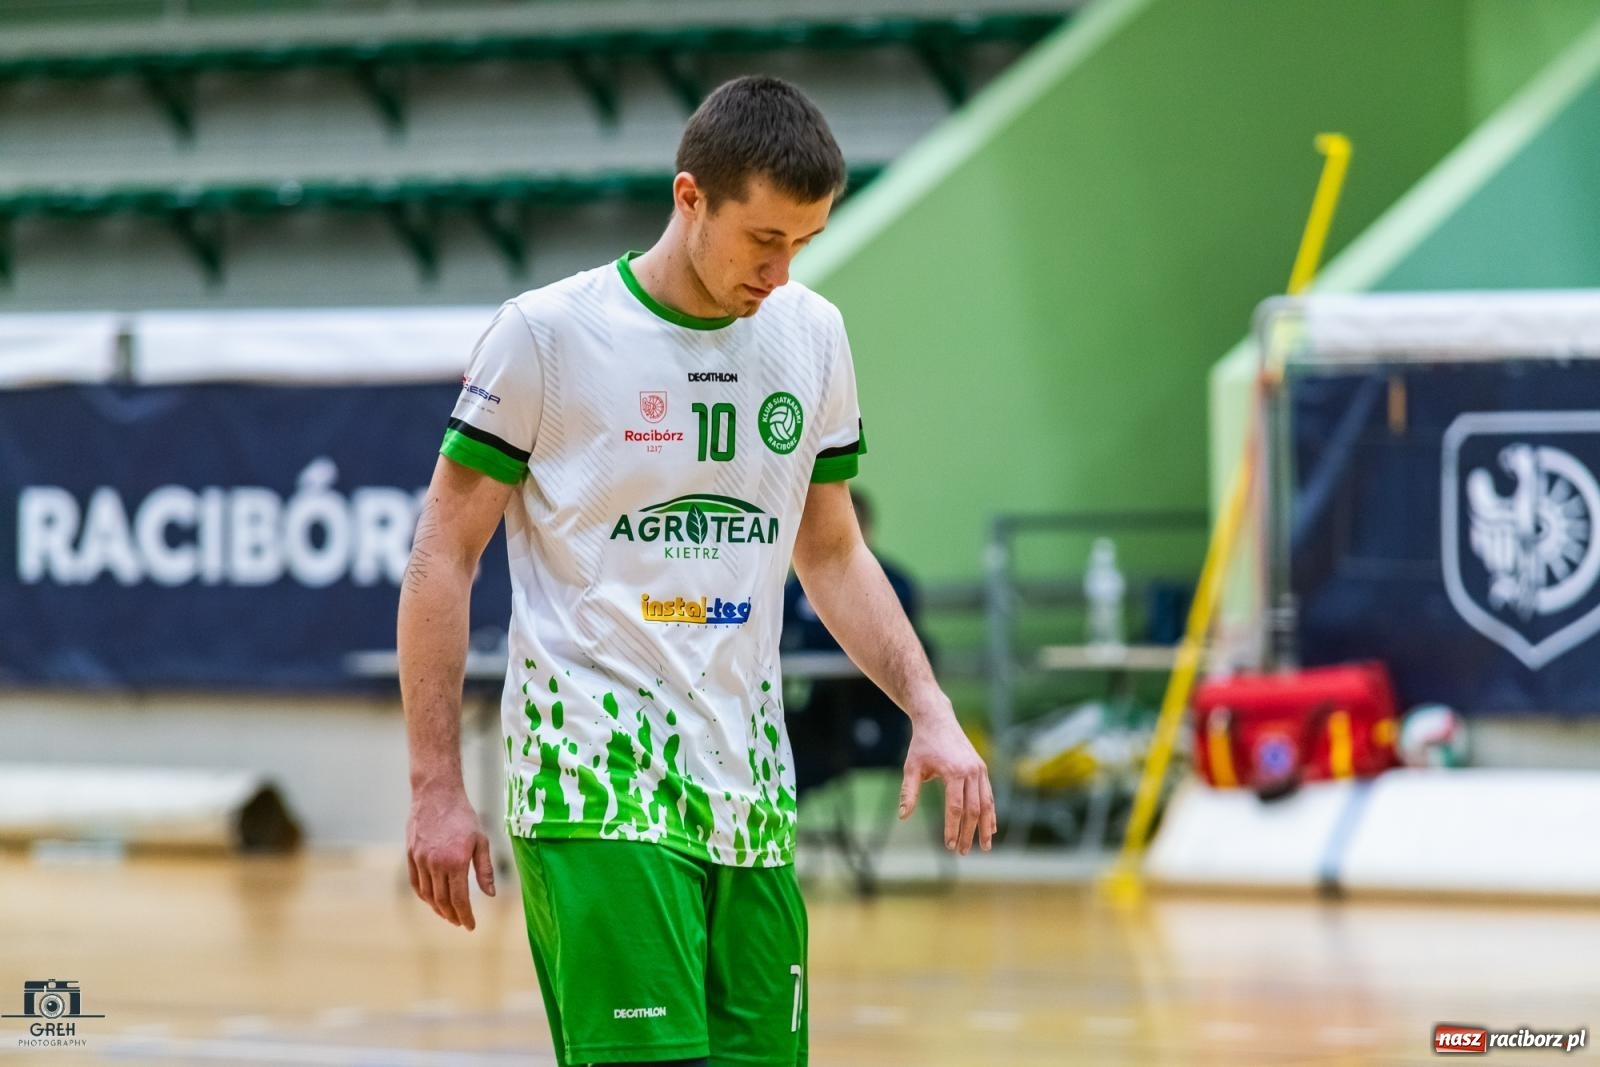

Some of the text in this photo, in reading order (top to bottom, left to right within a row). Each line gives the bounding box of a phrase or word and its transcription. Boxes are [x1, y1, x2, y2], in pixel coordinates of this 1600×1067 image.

[688, 372, 738, 383] DECATHLON
[772, 396, 802, 424] SIATKARSKI
[624, 429, 684, 442] Racibórz
[691, 402, 736, 462] 10
[646, 445, 663, 454] 1217
[17, 456, 428, 588] RACIBÓR
[664, 547, 720, 560] KIETRZ
[641, 593, 752, 624] instal-tec
[613, 1006, 667, 1019] DECATHLON
